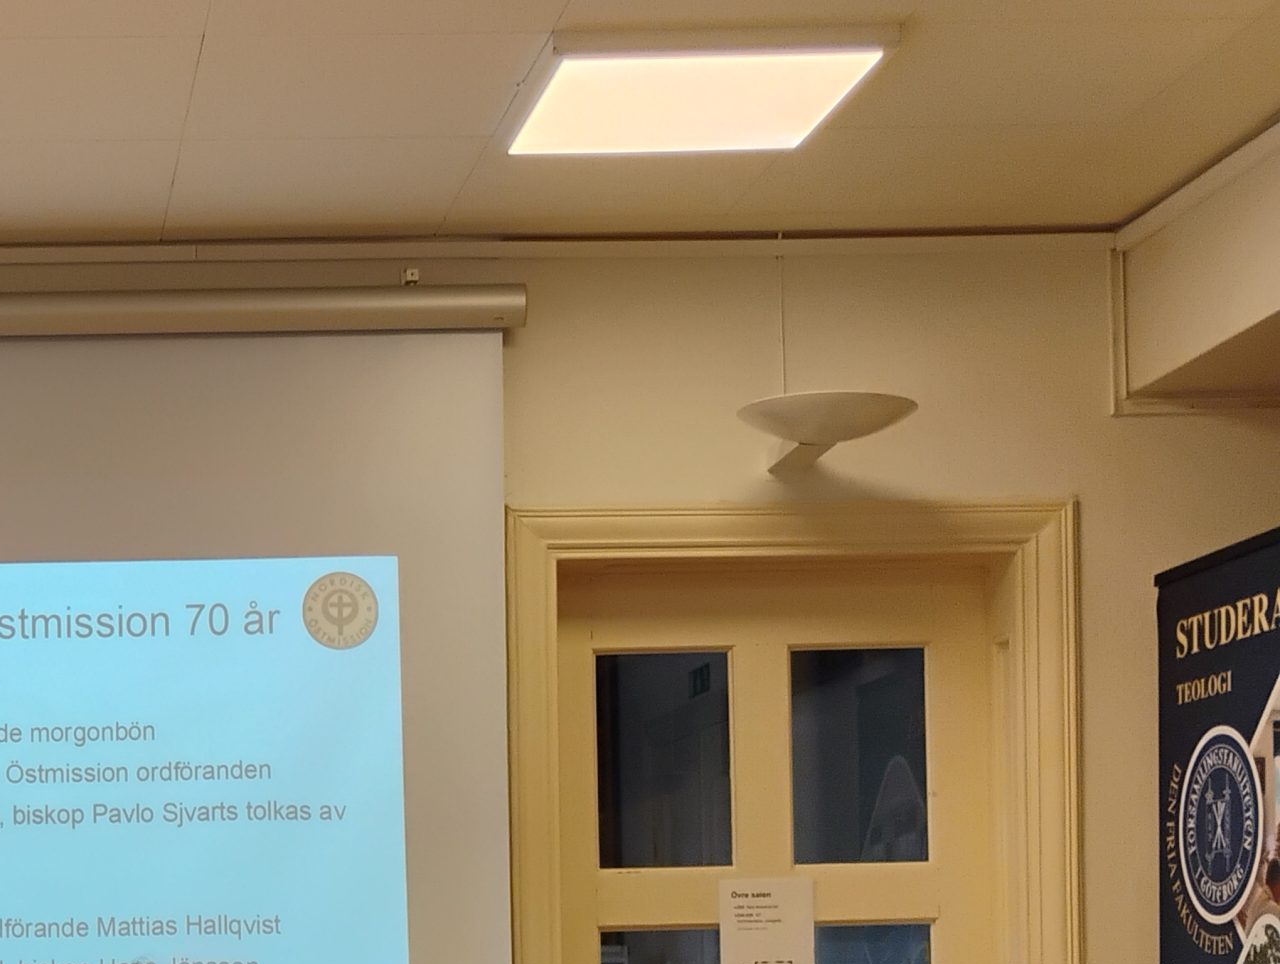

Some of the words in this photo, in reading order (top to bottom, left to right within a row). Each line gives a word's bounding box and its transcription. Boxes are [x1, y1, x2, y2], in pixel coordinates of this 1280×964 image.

[185, 603, 229, 636] 70
[244, 600, 280, 635] år
[1176, 670, 1232, 705] TEOLOGI
[31, 721, 155, 747] morgonbön
[6, 760, 128, 784] Östmission
[136, 760, 271, 782] ordföranden
[1167, 763, 1182, 814] DEN
[13, 805, 84, 830] biskop
[93, 803, 154, 824] Pavlo
[163, 802, 238, 828] Sjvarts
[246, 800, 311, 821] tolkas
[320, 805, 346, 820] av
[1166, 821, 1177, 878] FRIA
[97, 916, 177, 937] Mattias
[186, 914, 281, 940] Hallqvist
[1172, 879, 1234, 955] FAKULTETEN
